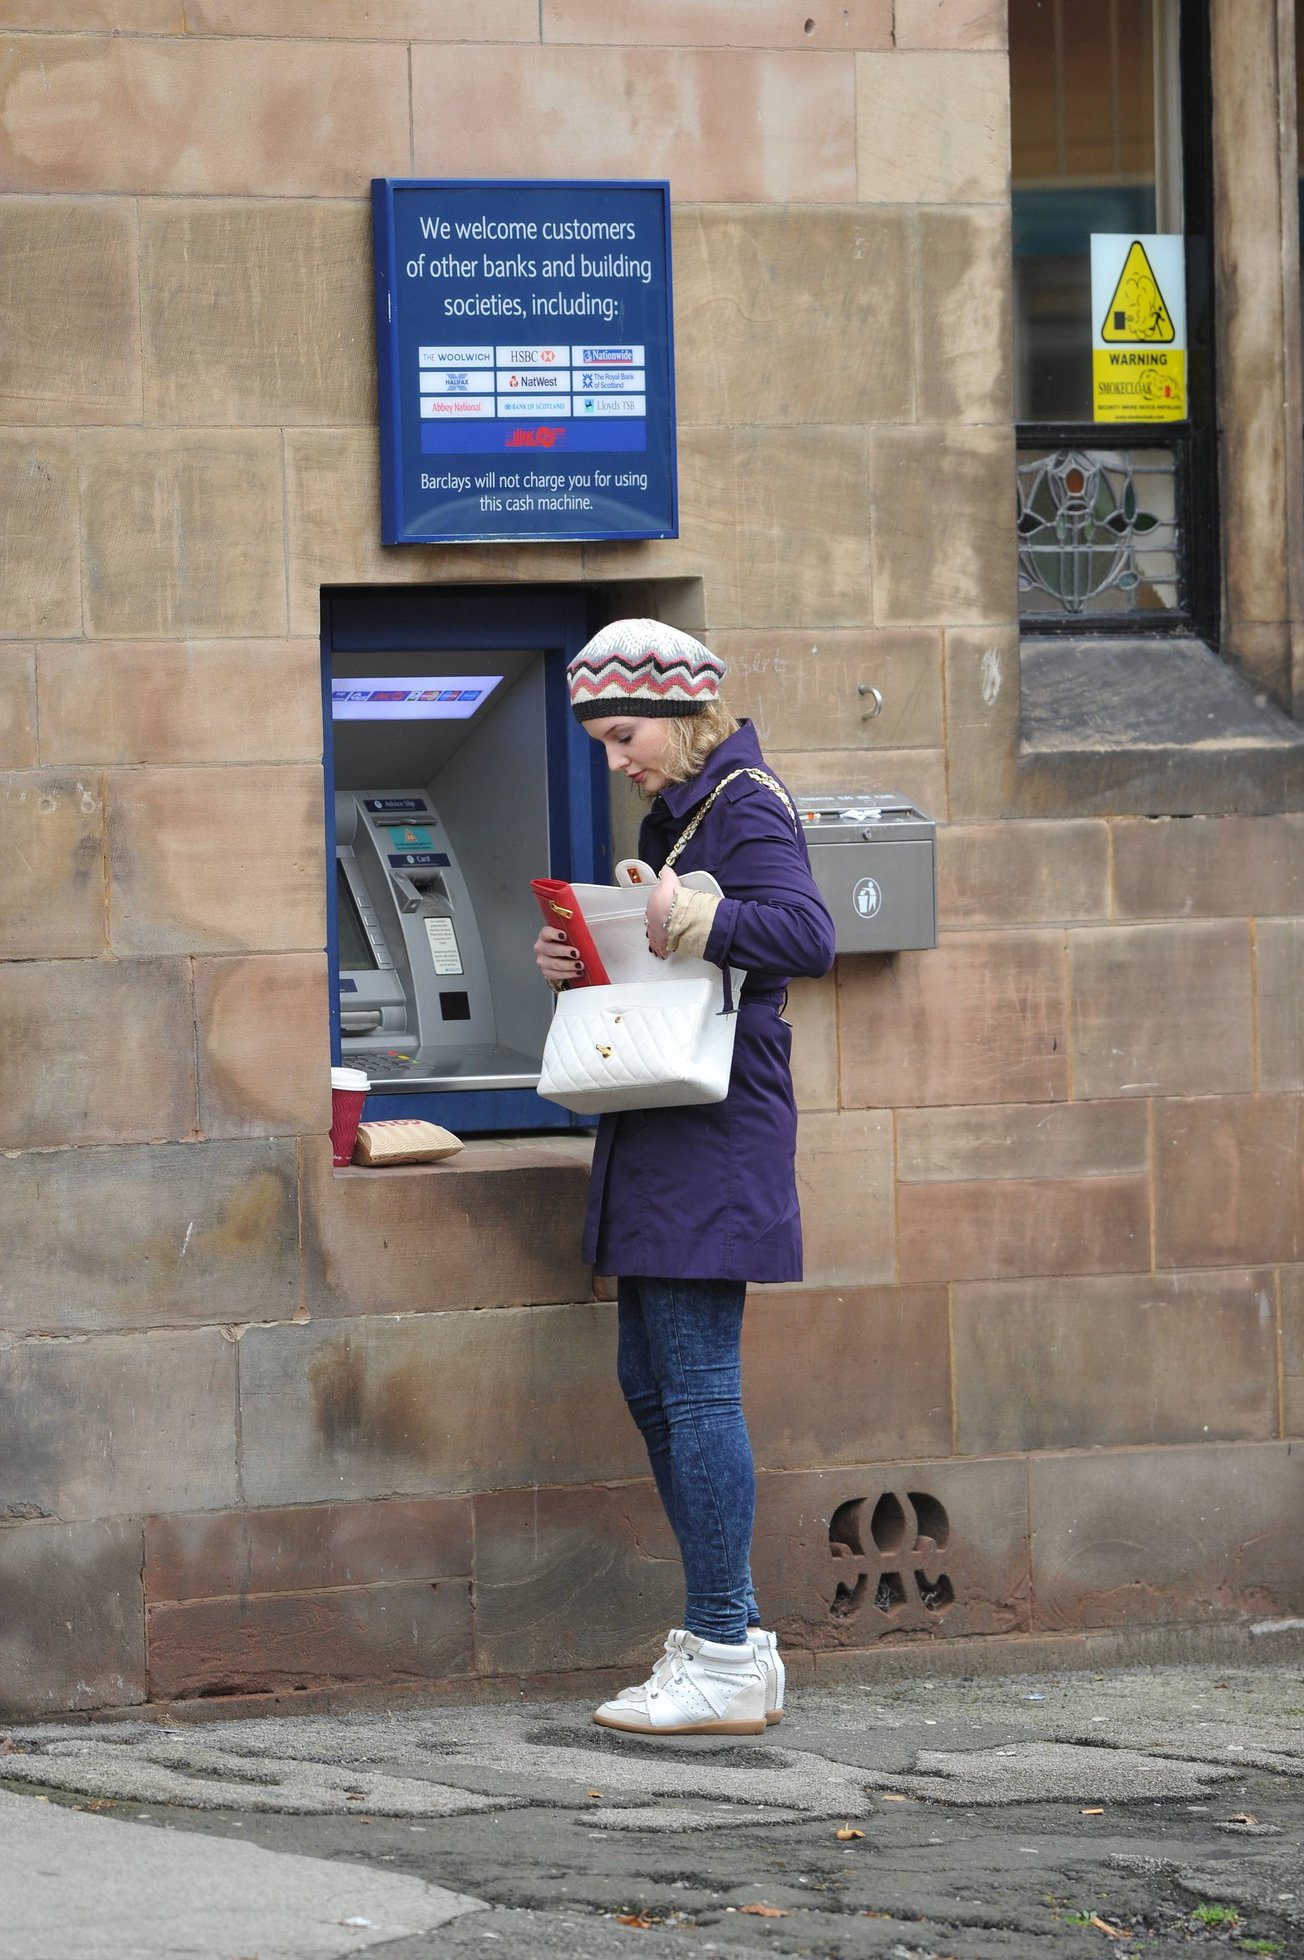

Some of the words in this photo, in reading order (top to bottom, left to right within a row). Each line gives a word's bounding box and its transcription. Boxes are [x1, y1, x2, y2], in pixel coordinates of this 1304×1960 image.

[419, 216, 451, 240] We
[455, 216, 538, 240] welcome
[542, 218, 636, 240] customers
[406, 254, 426, 278] of
[429, 254, 478, 278] other
[483, 254, 537, 278] banks
[542, 254, 575, 278] and
[581, 254, 652, 284] building
[444, 294, 527, 319] societies,
[532, 292, 619, 321] including:
[438, 353, 491, 361] WOOLWICH
[510, 350, 539, 363] HSBC
[593, 349, 632, 361] Nationwide
[1109, 354, 1168, 365] WARNING
[521, 376, 557, 387] NatWest
[605, 373, 620, 381] Royal
[1098, 382, 1152, 395] SMOKECLOAK
[432, 403, 453, 414] Abbey
[454, 402, 481, 412] National
[597, 400, 620, 413] Lloyds
[622, 401, 635, 410] TSB
[421, 472, 471, 492] Barclays
[474, 471, 496, 488] will
[499, 473, 520, 488] not
[523, 471, 565, 492] charge
[568, 474, 591, 491] you
[594, 470, 612, 487] for
[614, 471, 648, 490] using
[480, 495, 503, 511] this
[505, 494, 535, 511] cash
[538, 494, 594, 511] machine.
